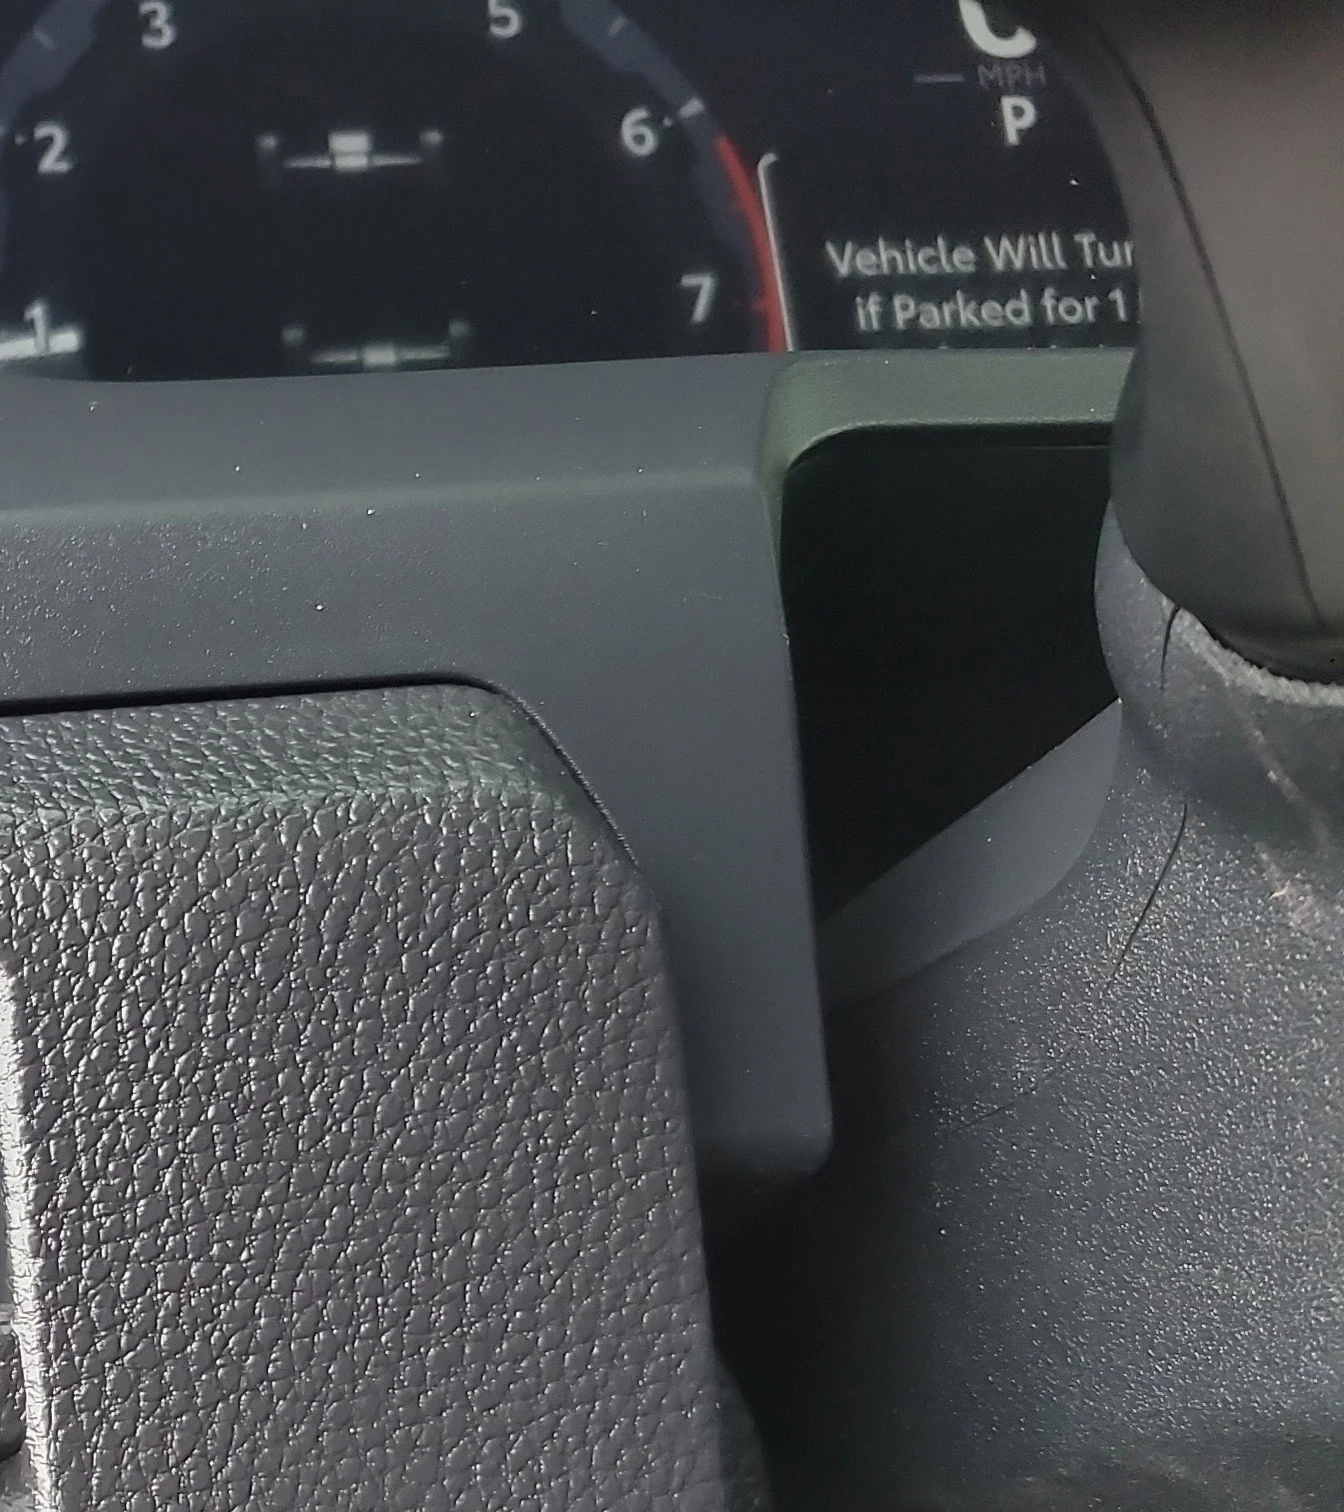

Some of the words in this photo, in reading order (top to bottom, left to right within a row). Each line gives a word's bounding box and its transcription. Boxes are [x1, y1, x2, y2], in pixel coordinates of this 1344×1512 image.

[138, 0, 176, 49] 3
[976, 63, 1046, 88] MPH
[621, 107, 658, 156] 6
[1001, 95, 1037, 145] P
[33, 121, 72, 174] 2
[825, 234, 976, 278] Vehicle
[983, 231, 1067, 273] Will
[680, 272, 714, 324] 7
[856, 291, 882, 332] if
[891, 289, 1033, 330] Parked
[1040, 286, 1099, 325] for
[1108, 287, 1128, 323] 1
[23, 301, 49, 351] 1
